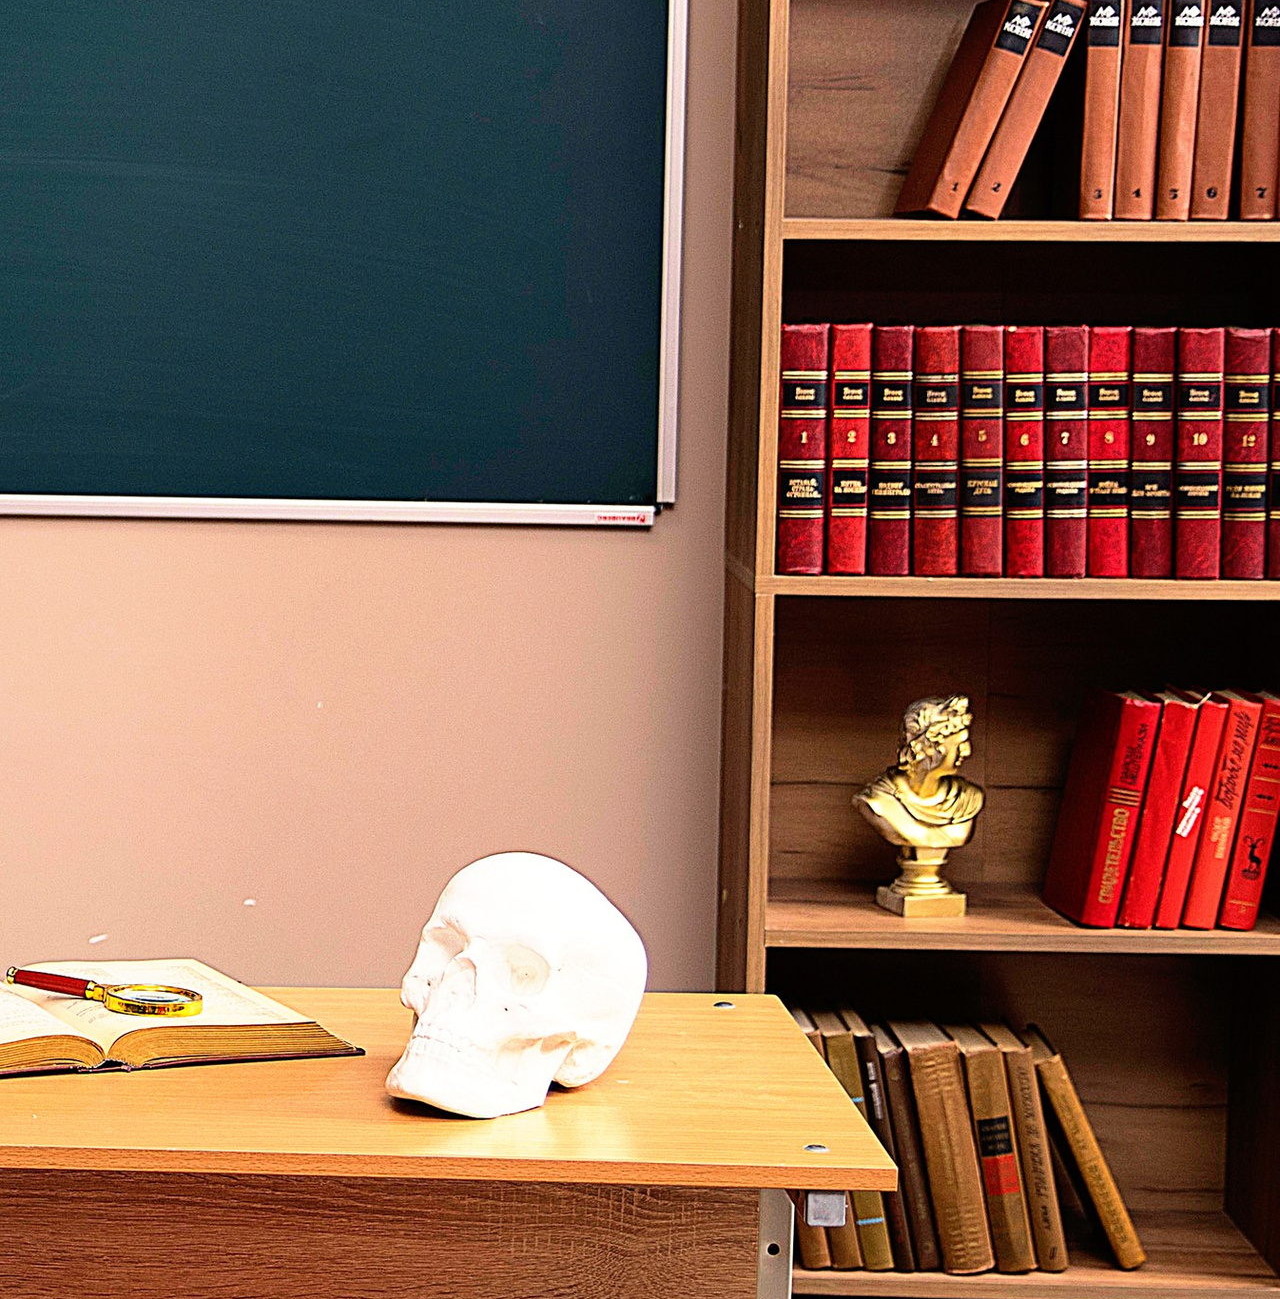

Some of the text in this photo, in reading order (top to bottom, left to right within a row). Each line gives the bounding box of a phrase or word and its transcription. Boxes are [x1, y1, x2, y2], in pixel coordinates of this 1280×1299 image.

[951, 181, 959, 193] 1
[991, 181, 1002, 193] 2
[1131, 187, 1142, 199] 4
[1206, 187, 1218, 199] 6
[1256, 187, 1267, 199] 7
[1093, 188, 1103, 200] 3
[1169, 188, 1179, 200] 5
[800, 431, 808, 443] 1
[847, 430, 856, 443] 2
[887, 432, 896, 445] 3
[930, 434, 939, 446] 4
[978, 429, 987, 442] 5
[1020, 433, 1030, 446] 6
[1061, 431, 1070, 445] 7
[1104, 431, 1114, 444] 8
[1146, 433, 1156, 446] 9
[1192, 432, 1208, 446] 10
[1242, 434, 1256, 447] 12
